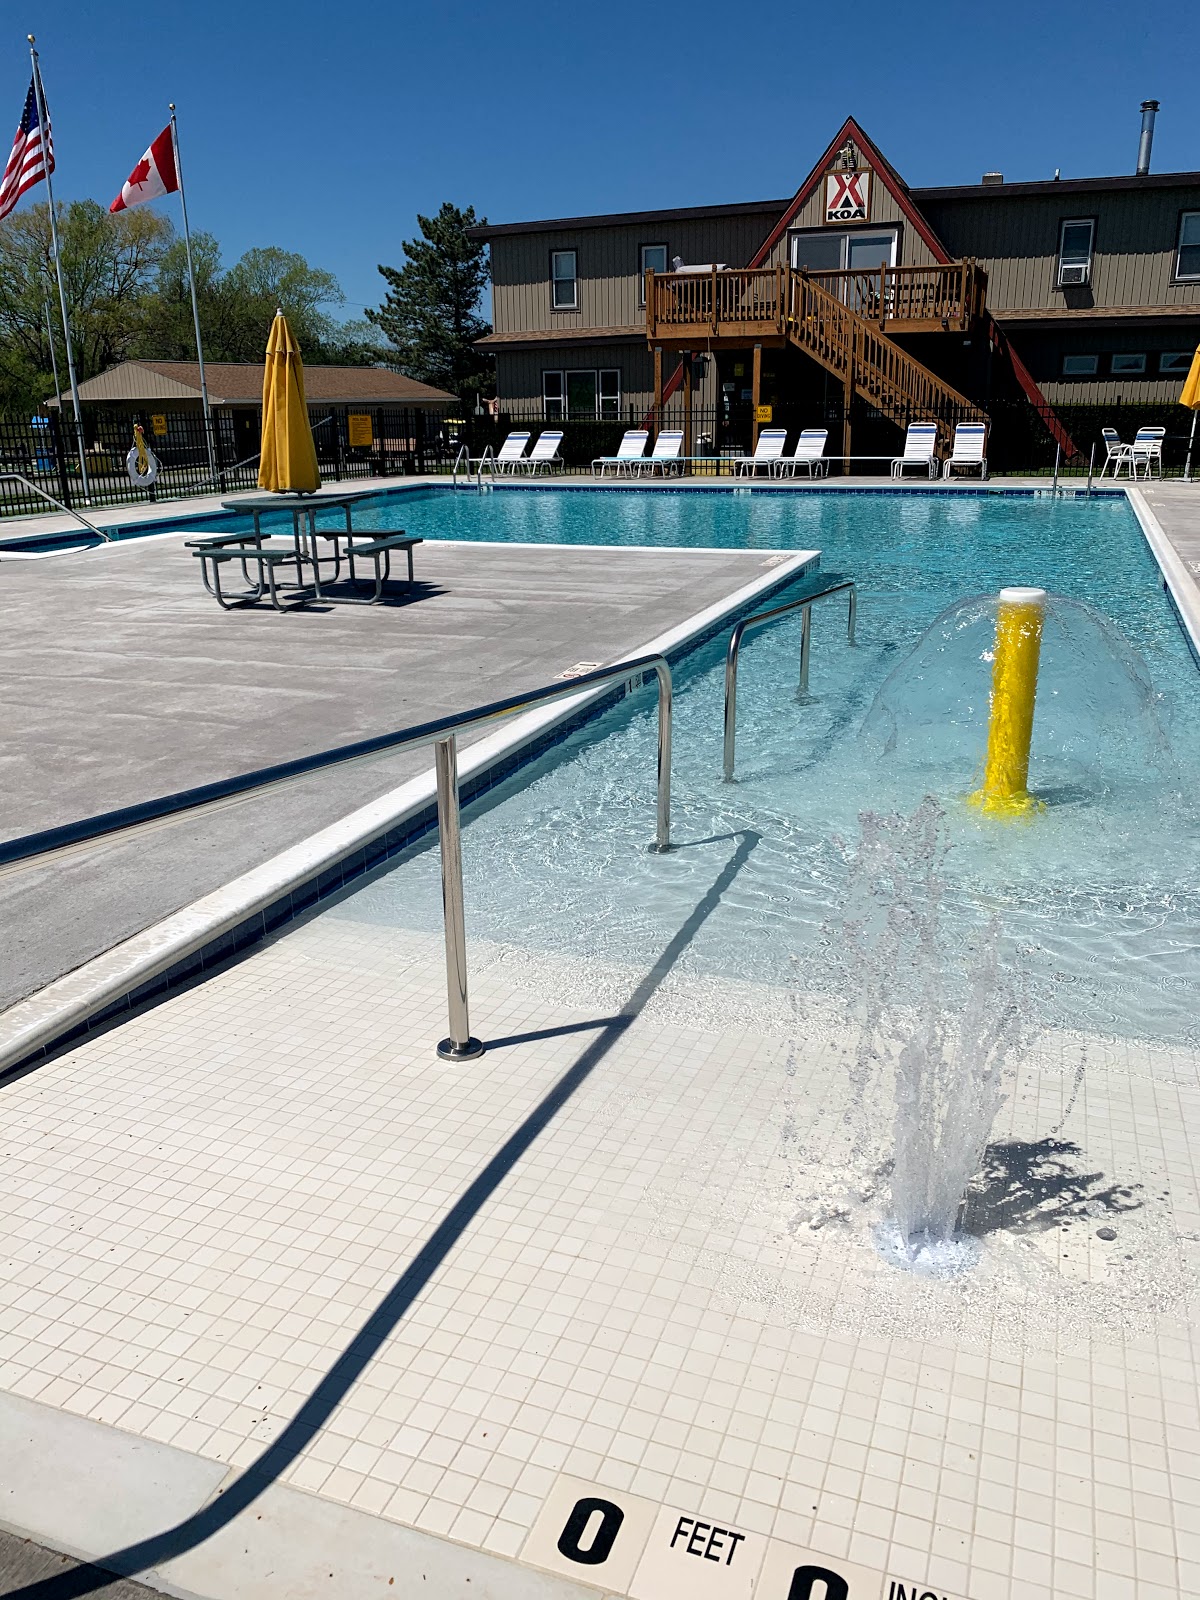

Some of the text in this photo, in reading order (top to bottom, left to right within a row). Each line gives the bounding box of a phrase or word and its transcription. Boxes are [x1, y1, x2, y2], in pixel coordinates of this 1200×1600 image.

[828, 209, 865, 220] KOA
[557, 1497, 625, 1565] 0
[670, 1516, 746, 1566] FEET
